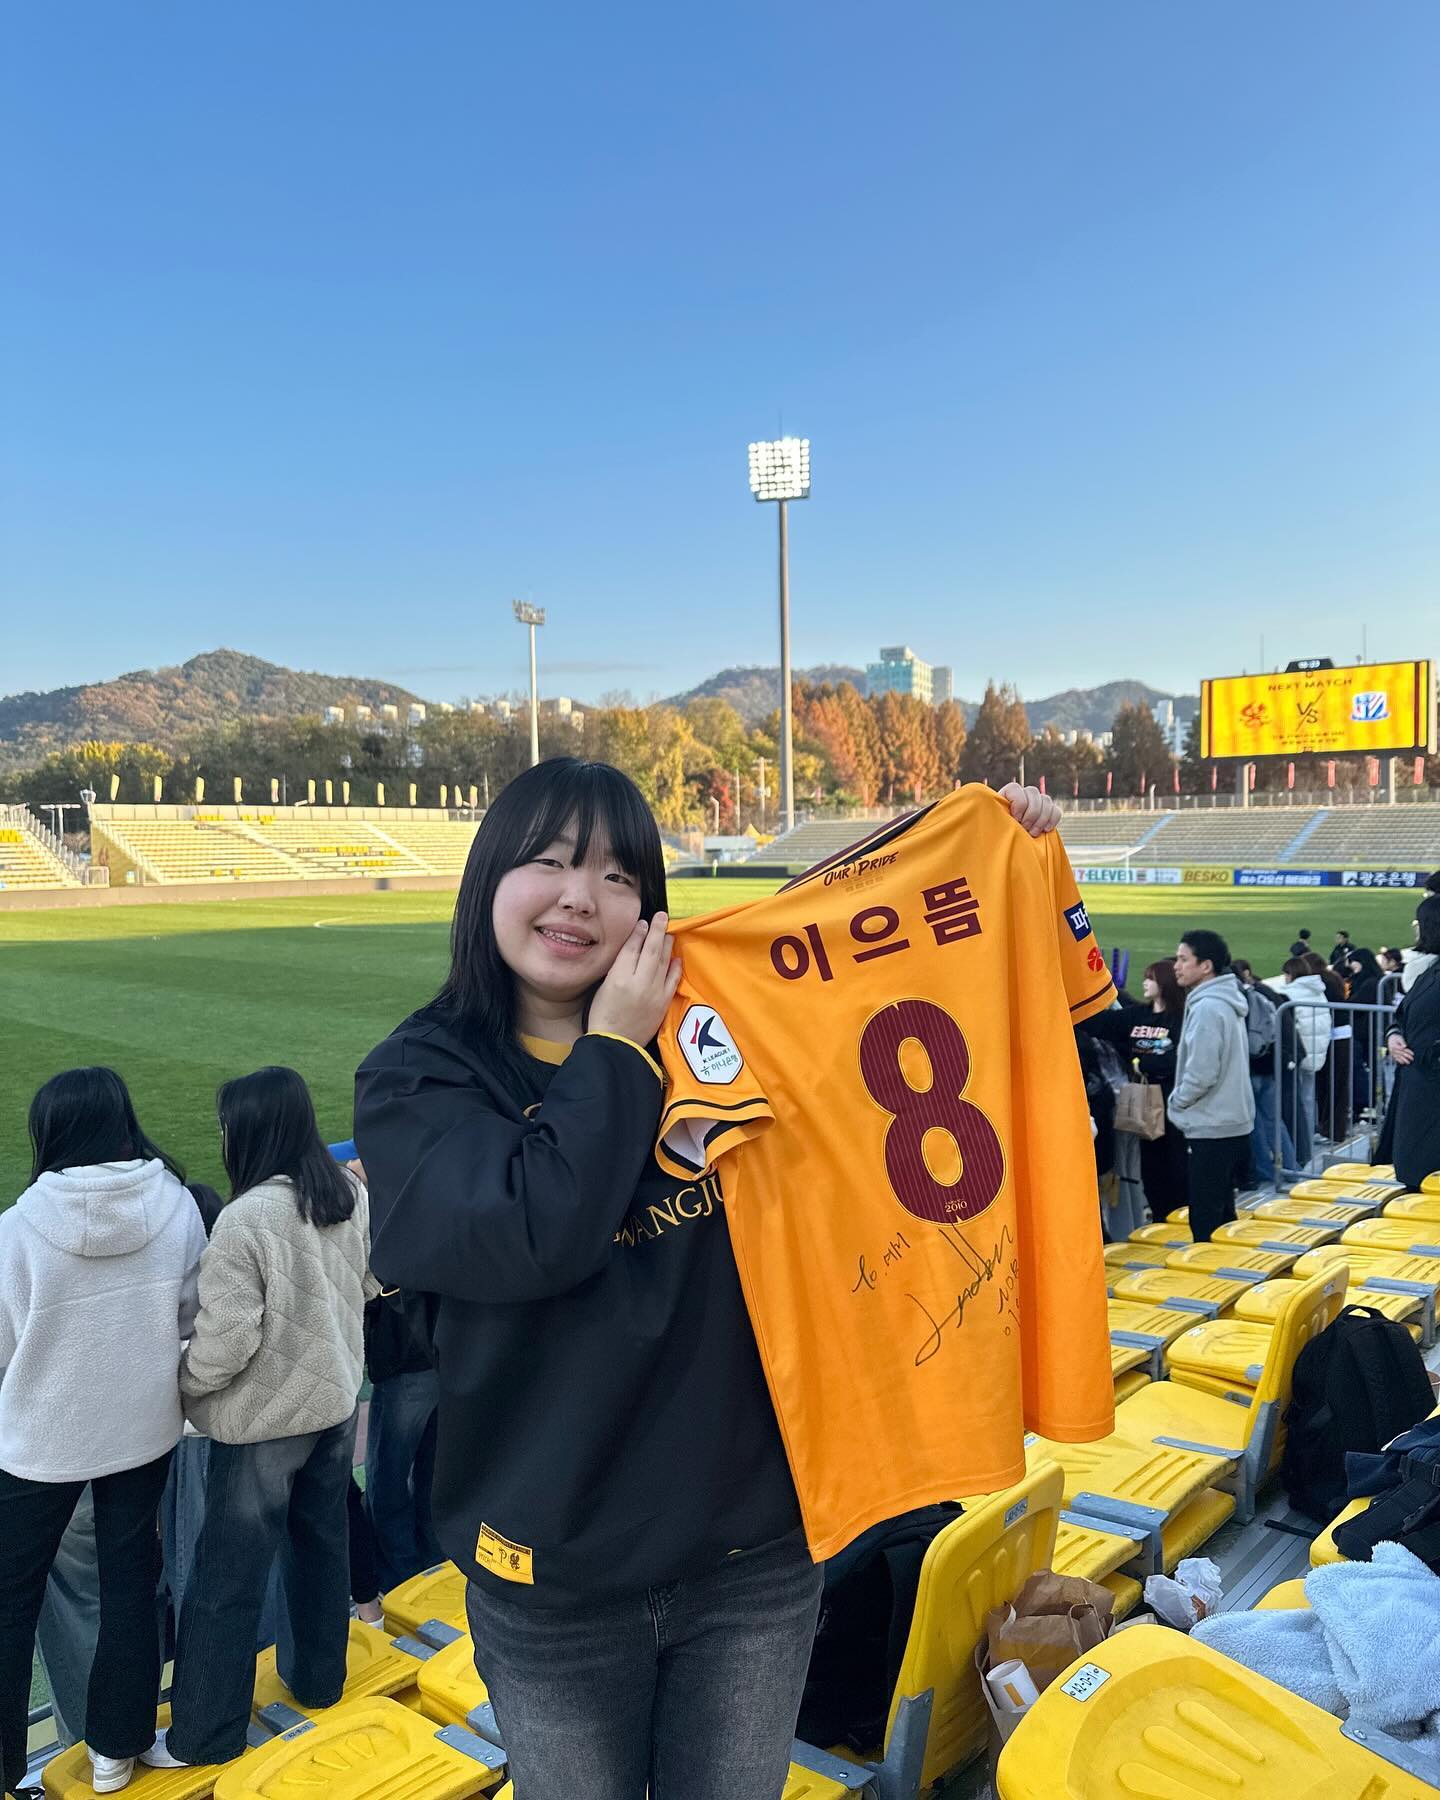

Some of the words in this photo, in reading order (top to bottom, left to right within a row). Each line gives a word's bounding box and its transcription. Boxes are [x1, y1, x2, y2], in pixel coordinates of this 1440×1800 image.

[1268, 682, 1300, 691] NEXT
[1305, 678, 1352, 688] MATCH
[1296, 701, 1318, 724] VS
[824, 866, 850, 886] OUR
[858, 851, 899, 875] PRIDE
[1184, 870, 1230, 883] BESKO
[1359, 870, 1417, 886] 광주은행
[769, 876, 982, 982] 이으뜸
[1070, 904, 1089, 930] 파
[857, 997, 1007, 1227] 8
[613, 1174, 724, 1247] WANGJ
[944, 1201, 968, 1213] 2010
